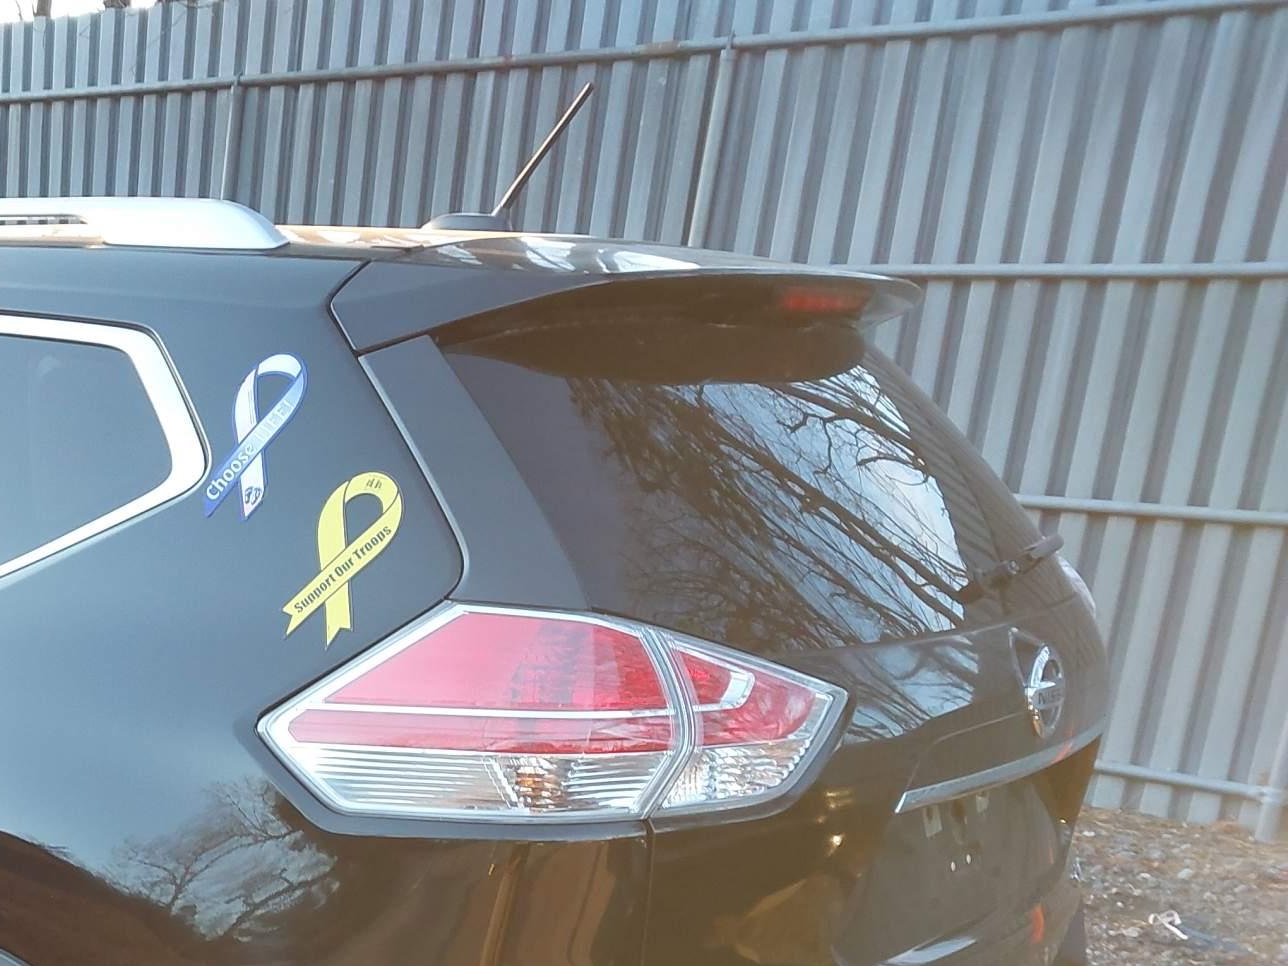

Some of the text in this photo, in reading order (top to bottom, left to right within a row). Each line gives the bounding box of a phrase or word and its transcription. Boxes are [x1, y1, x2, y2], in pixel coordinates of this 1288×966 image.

[206, 444, 255, 500] Choose
[294, 526, 392, 613] Support Our Troops
